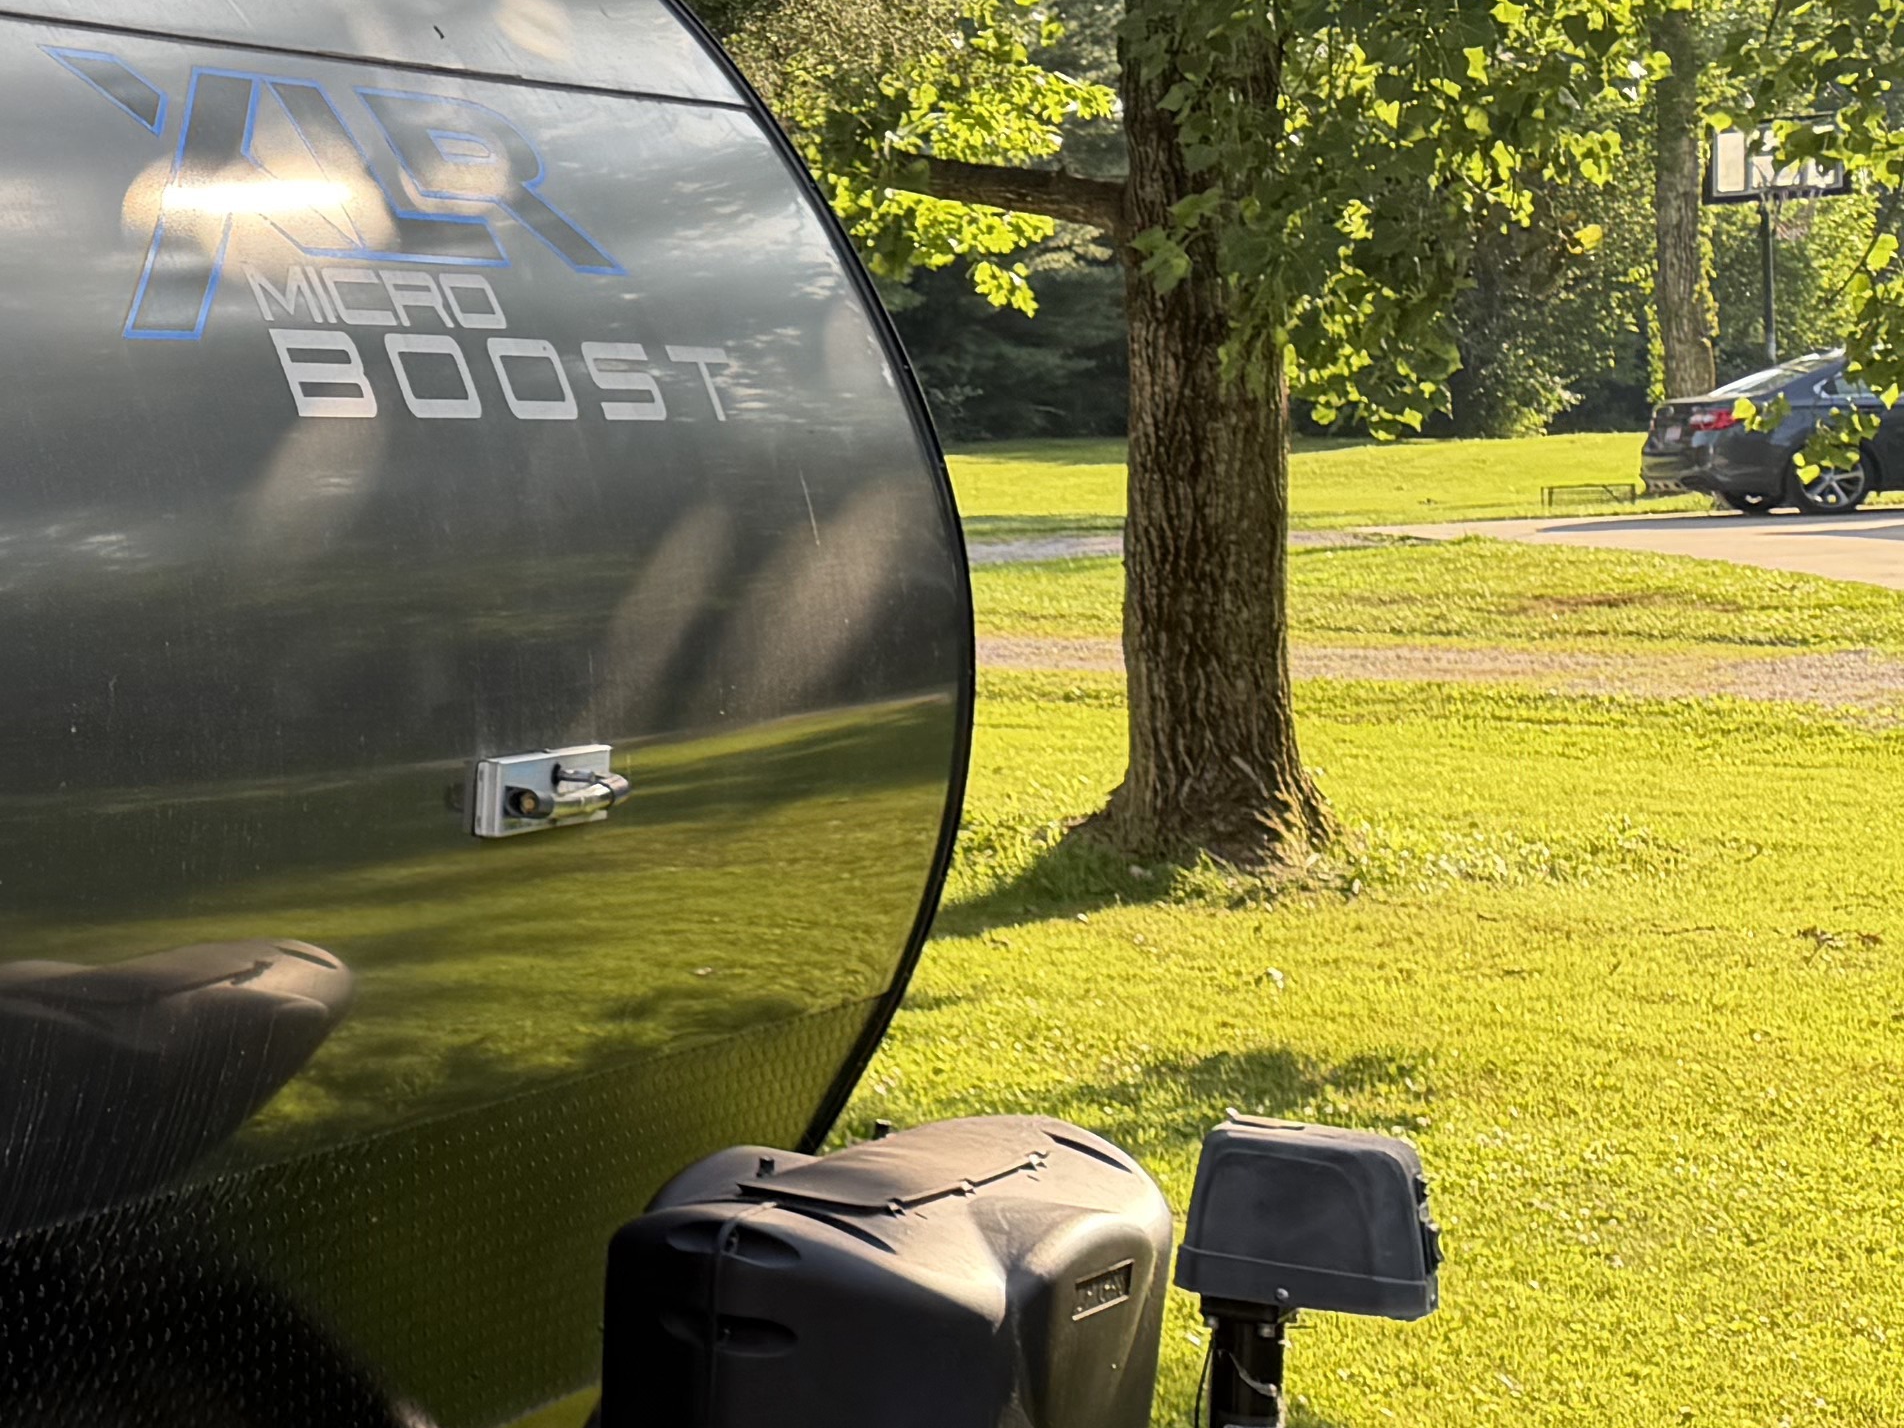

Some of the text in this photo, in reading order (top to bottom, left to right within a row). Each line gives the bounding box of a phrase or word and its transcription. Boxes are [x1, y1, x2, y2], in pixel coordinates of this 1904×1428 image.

[38, 44, 628, 340] XLR
[244, 266, 508, 329] MICRO
[268, 328, 730, 421] BOOST
